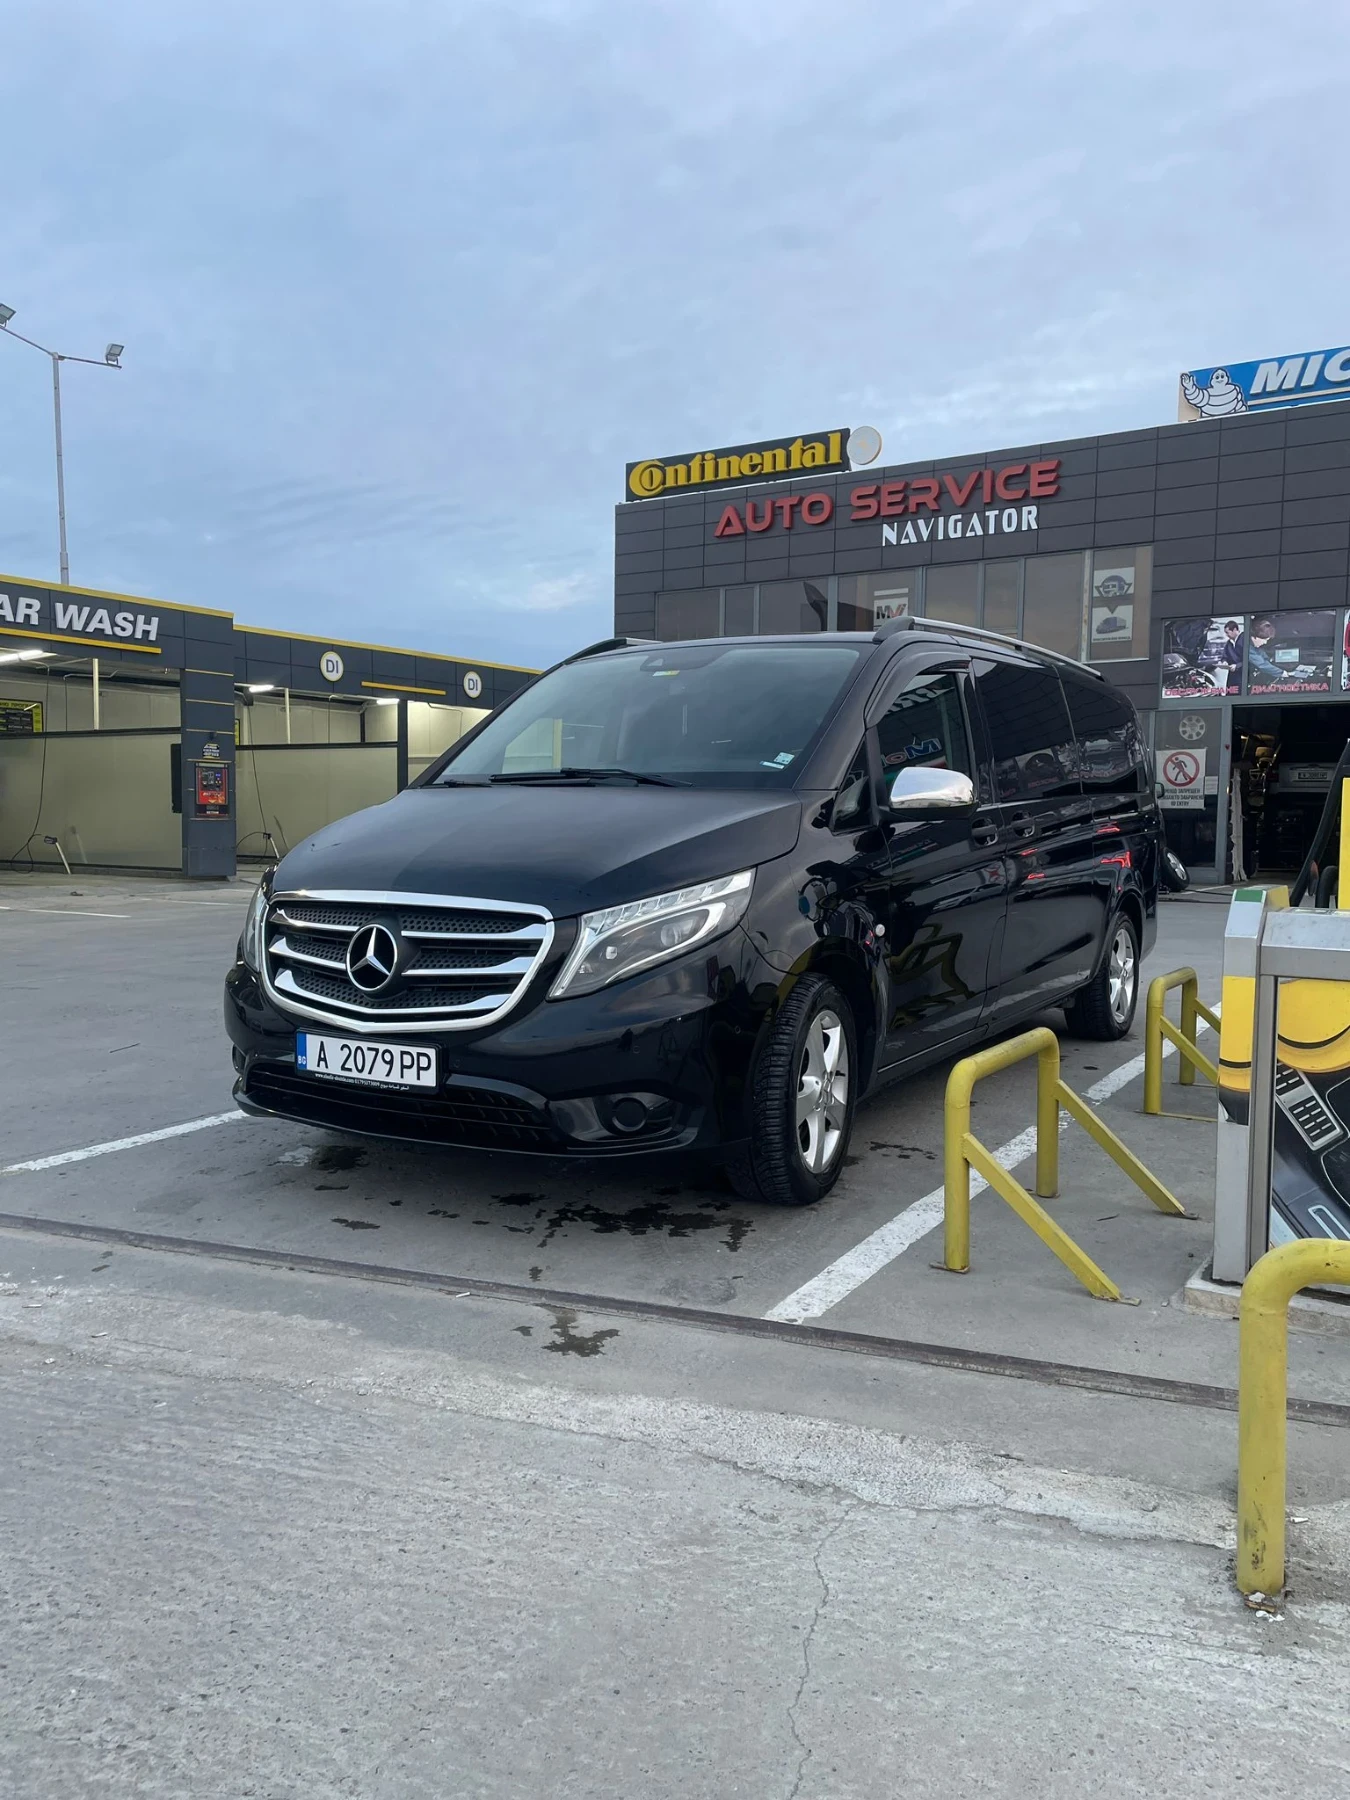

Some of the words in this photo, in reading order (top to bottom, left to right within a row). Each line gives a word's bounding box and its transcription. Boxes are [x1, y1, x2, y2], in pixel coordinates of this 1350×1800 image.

[629, 432, 842, 496] Continental
[714, 493, 834, 537] AUTO
[850, 460, 1062, 520] SERVICE
[882, 505, 1038, 547] NAVIGATOR
[55, 602, 159, 641] WASH
[298, 1055, 306, 1064] BG
[317, 1040, 328, 1069] A
